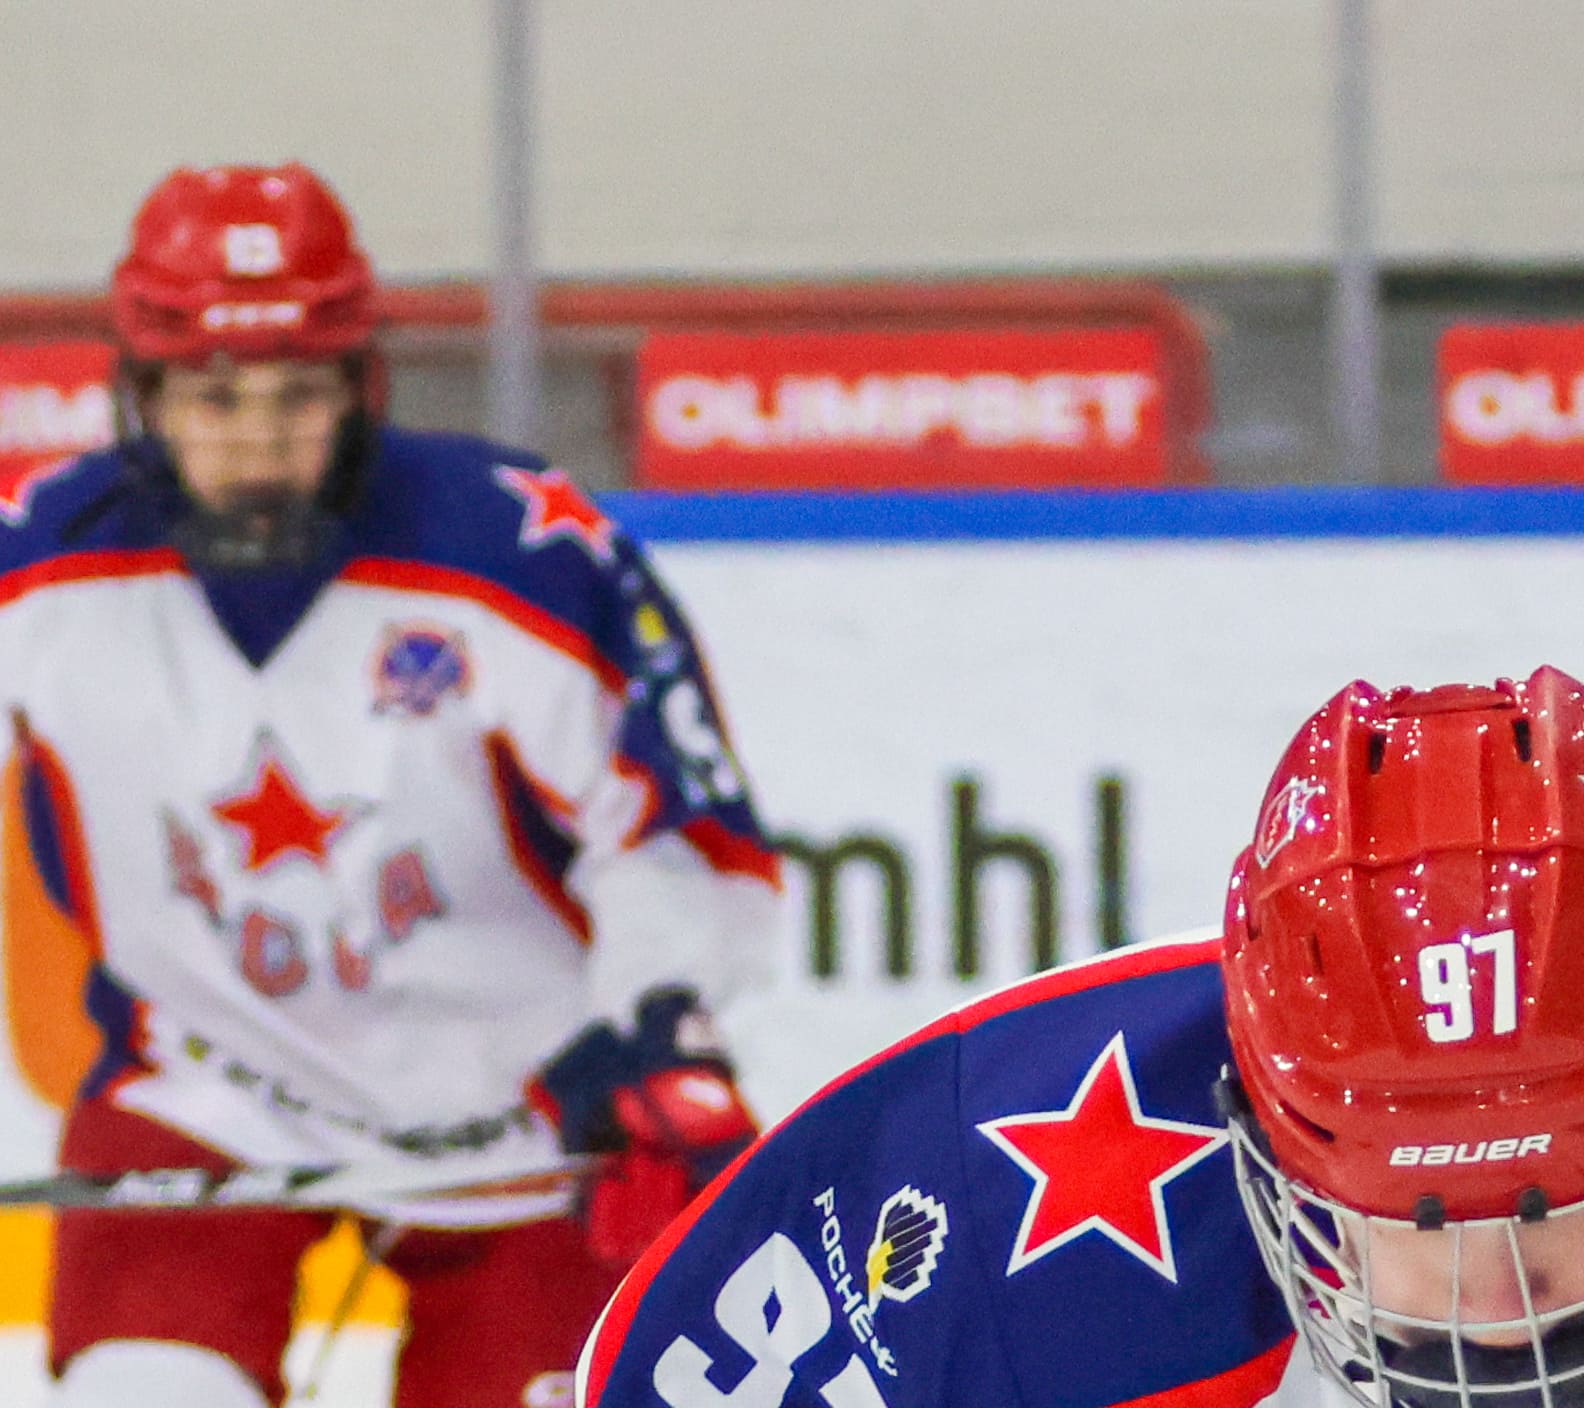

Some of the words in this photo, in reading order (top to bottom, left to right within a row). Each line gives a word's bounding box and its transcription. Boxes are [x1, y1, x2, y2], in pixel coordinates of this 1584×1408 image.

[1418, 929, 1518, 1043] 97
[1389, 1133, 1552, 1167] BAUER
[813, 1186, 899, 1377] РОСНЕ
